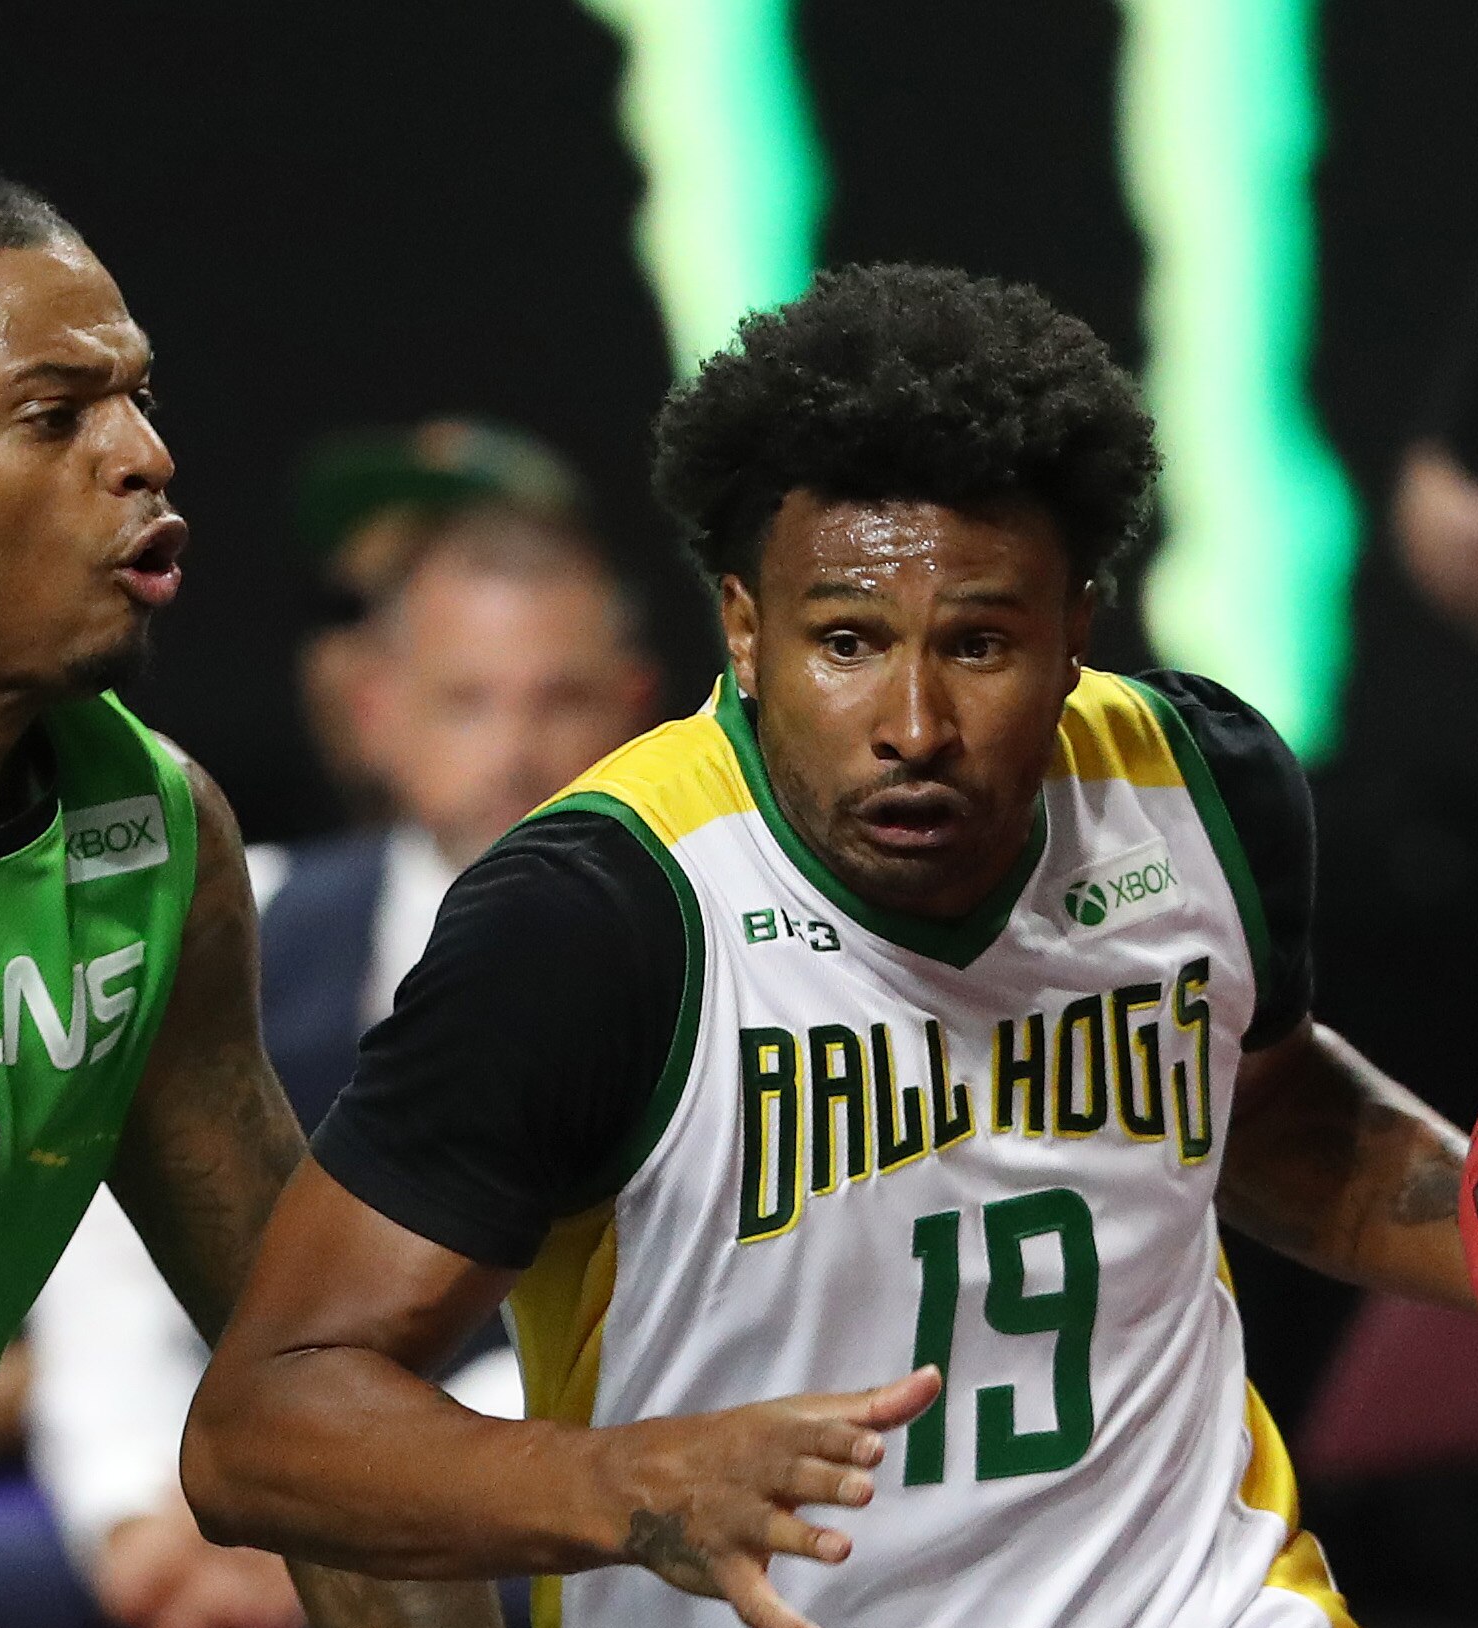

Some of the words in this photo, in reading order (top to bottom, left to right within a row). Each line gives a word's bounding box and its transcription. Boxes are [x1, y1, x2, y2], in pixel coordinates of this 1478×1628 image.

[741, 906, 842, 952] BI3
[1106, 858, 1179, 908] XBOX
[738, 1018, 976, 1245] BALL
[990, 955, 1212, 1168] HOGS
[902, 1187, 1100, 1488] 19
